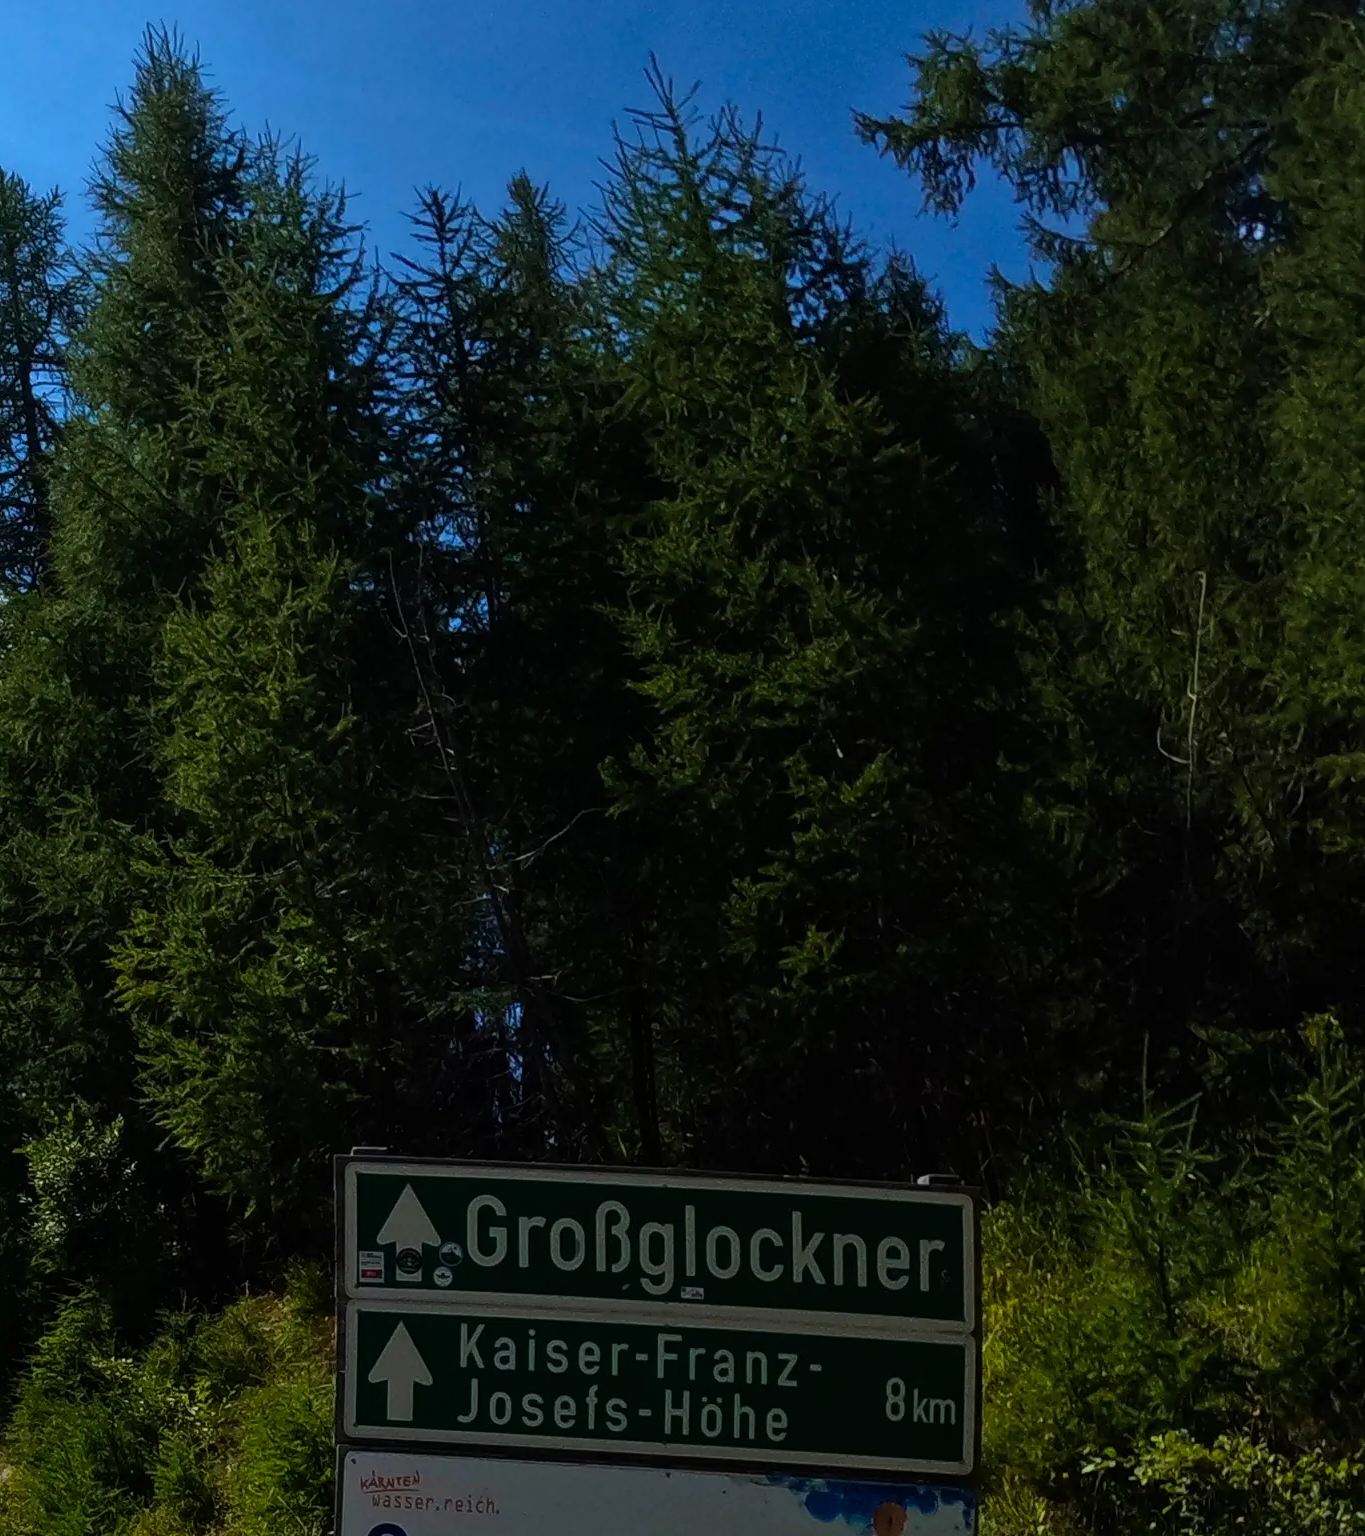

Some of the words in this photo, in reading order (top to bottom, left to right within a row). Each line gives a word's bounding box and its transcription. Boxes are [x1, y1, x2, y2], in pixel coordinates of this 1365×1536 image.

[465, 1193, 946, 1297] Großglockner
[458, 1322, 824, 1386] Kaiser-Franz-
[456, 1378, 789, 1443] Josefs-Höhe
[884, 1376, 907, 1423] 8
[912, 1386, 957, 1427] km
